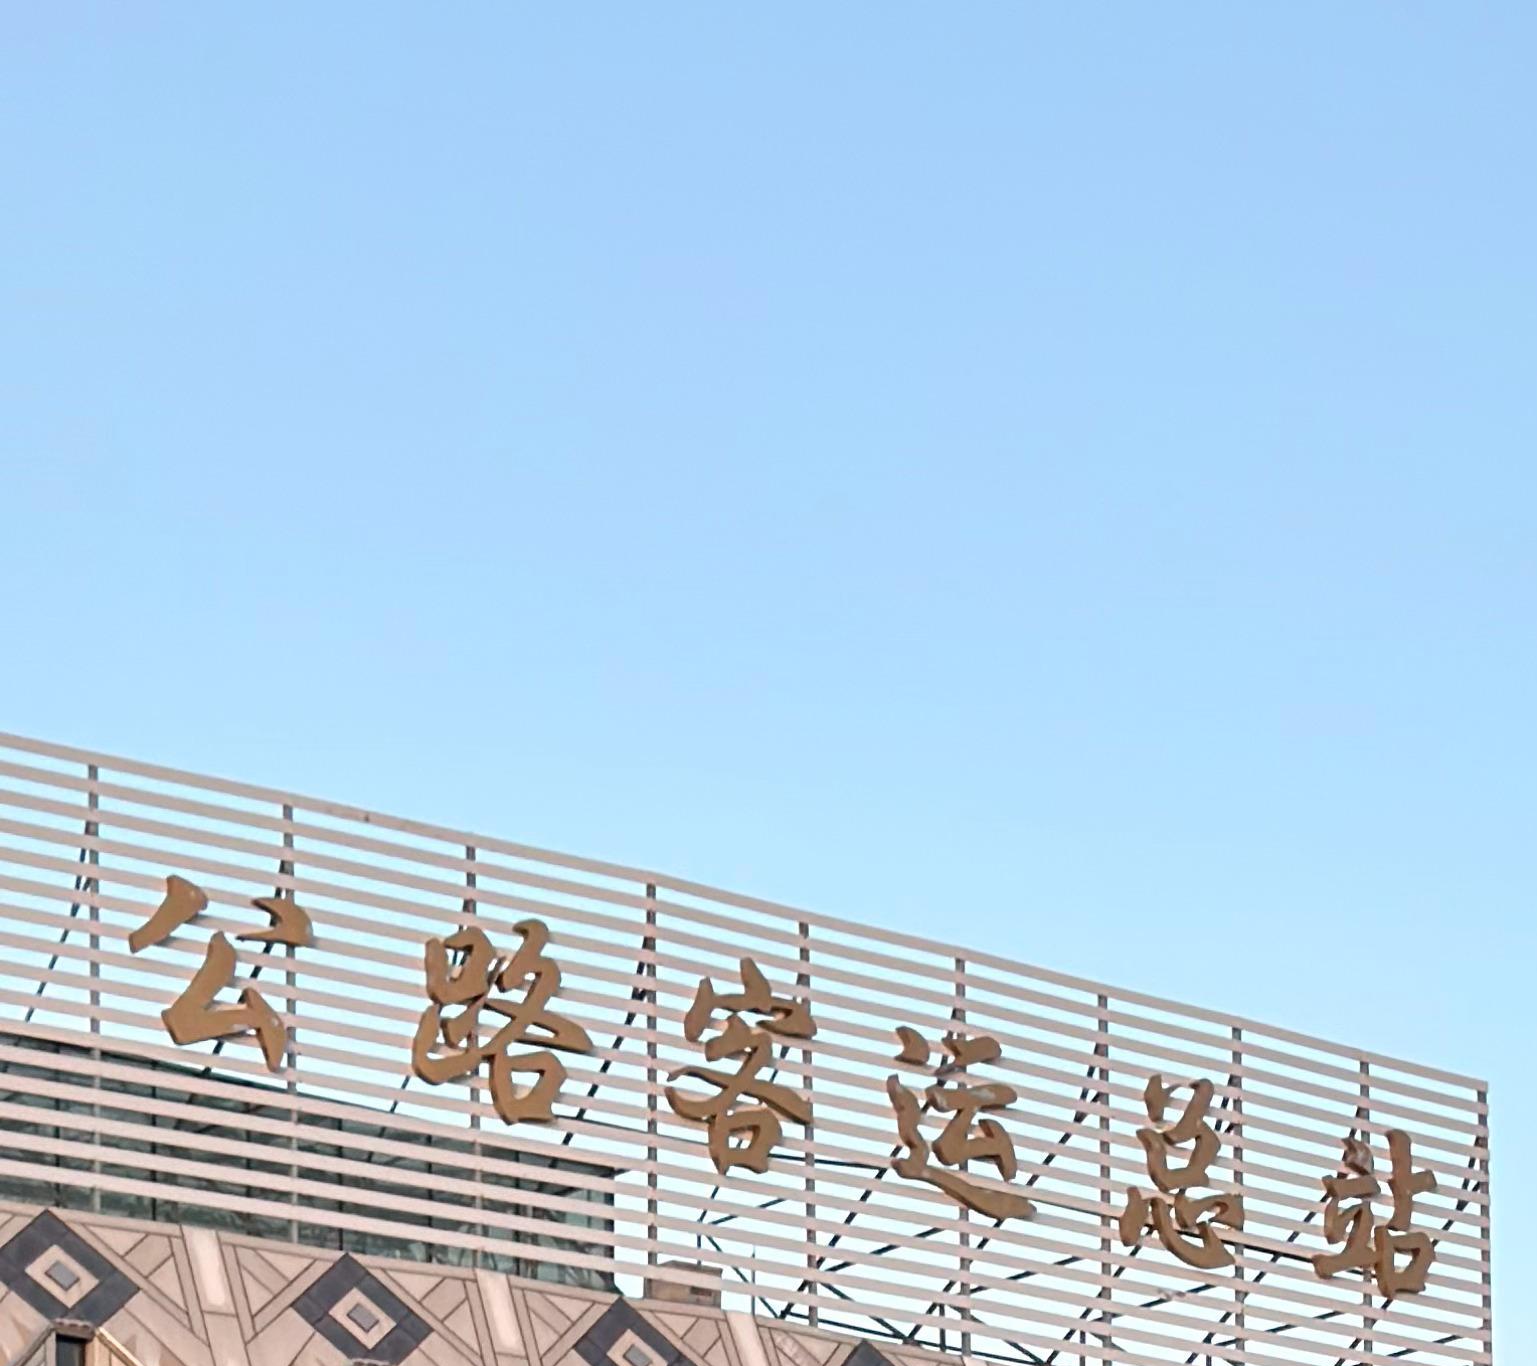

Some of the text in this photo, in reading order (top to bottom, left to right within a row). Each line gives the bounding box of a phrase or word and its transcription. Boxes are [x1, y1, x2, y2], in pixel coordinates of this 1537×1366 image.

[128, 874, 1437, 1300] 公路客运总站
